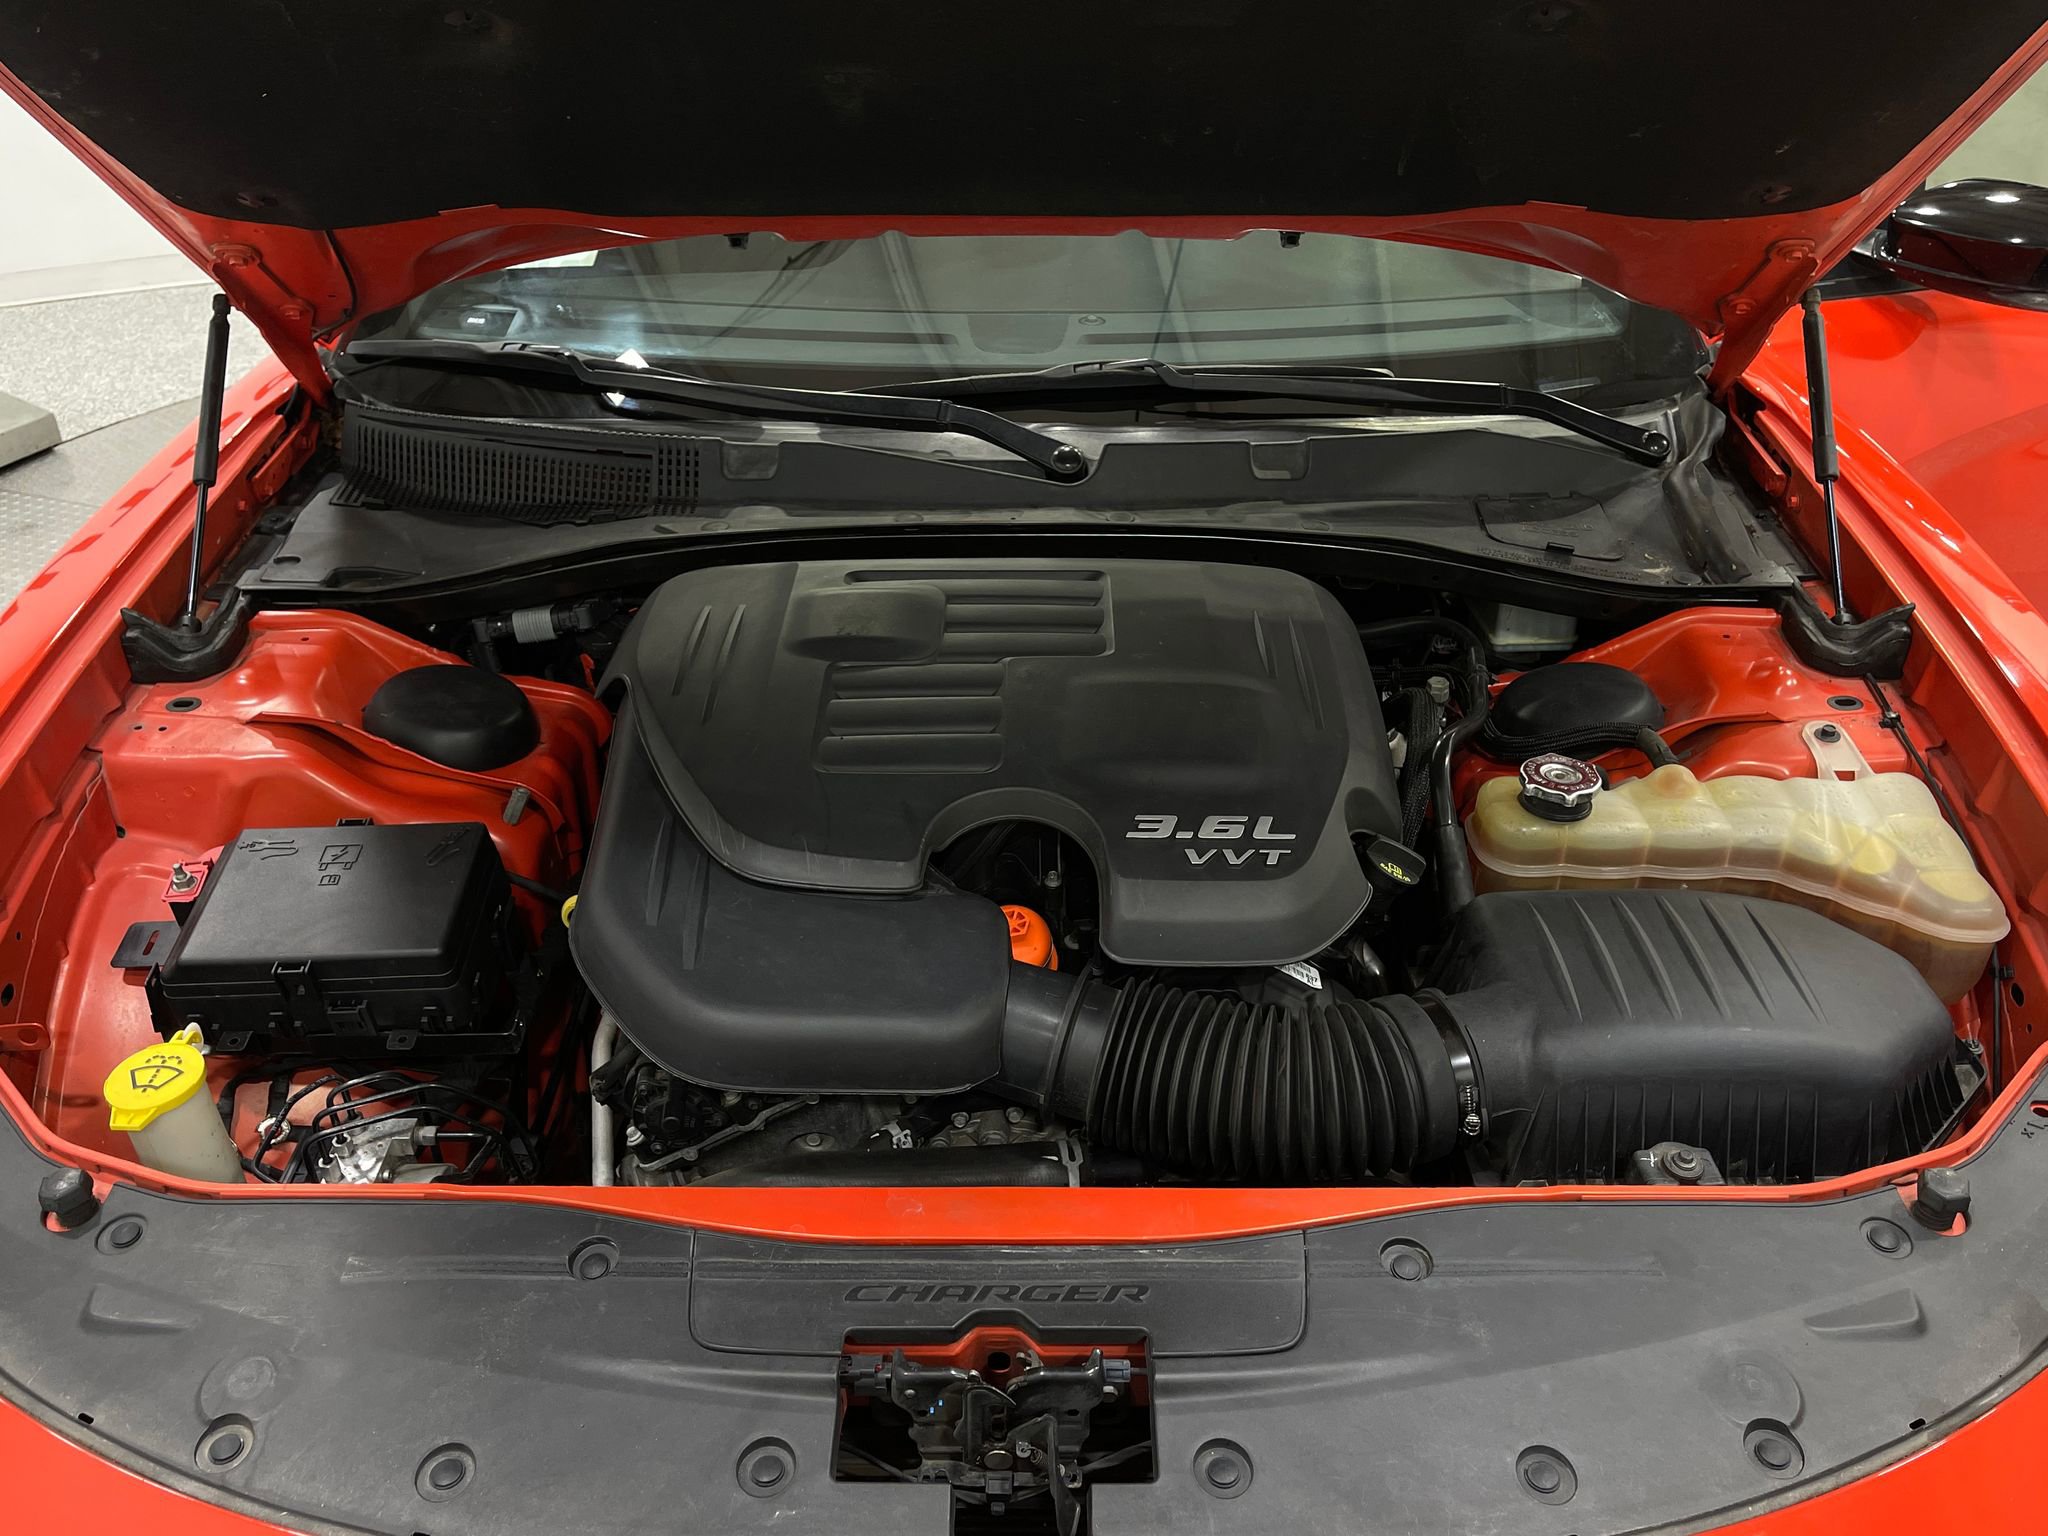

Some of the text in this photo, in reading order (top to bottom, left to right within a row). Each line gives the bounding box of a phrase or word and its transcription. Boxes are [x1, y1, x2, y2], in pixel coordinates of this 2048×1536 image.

[1125, 814, 1297, 840] 3.6L
[1184, 848, 1292, 866] VVT
[844, 1284, 1150, 1303] CHARGER
